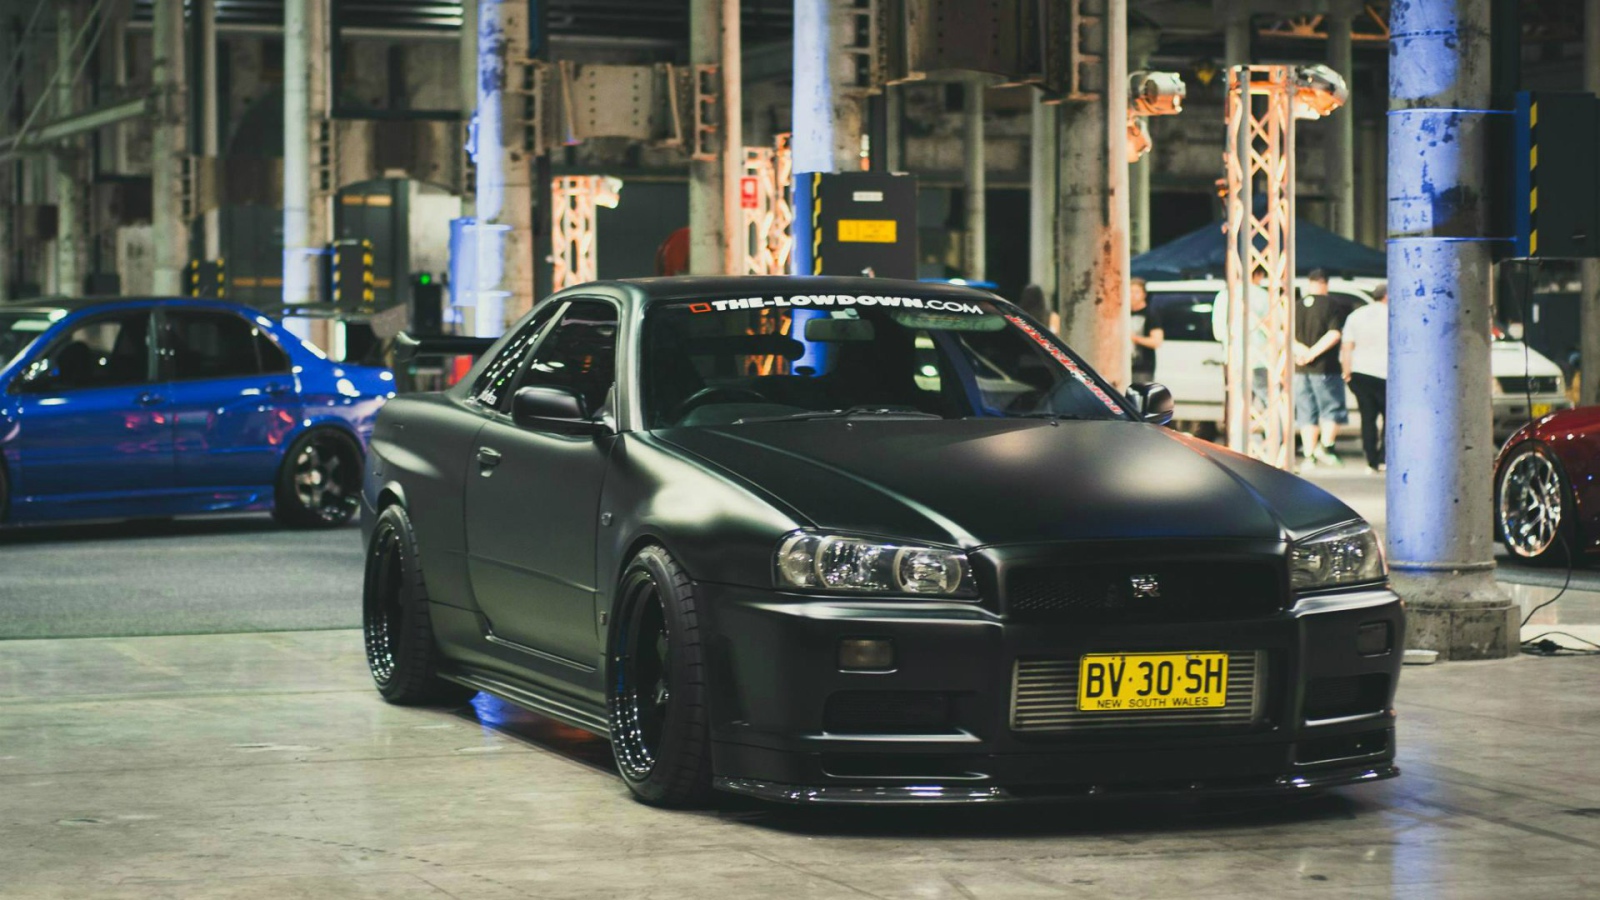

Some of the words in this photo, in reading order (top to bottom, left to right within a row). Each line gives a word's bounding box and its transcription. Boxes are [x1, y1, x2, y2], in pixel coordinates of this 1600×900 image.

[711, 294, 984, 315] THE-LOWDOWN.COM
[1097, 699, 1122, 708] NEW
[1128, 698, 1166, 708] SOUTH
[1172, 697, 1209, 706] WALES
